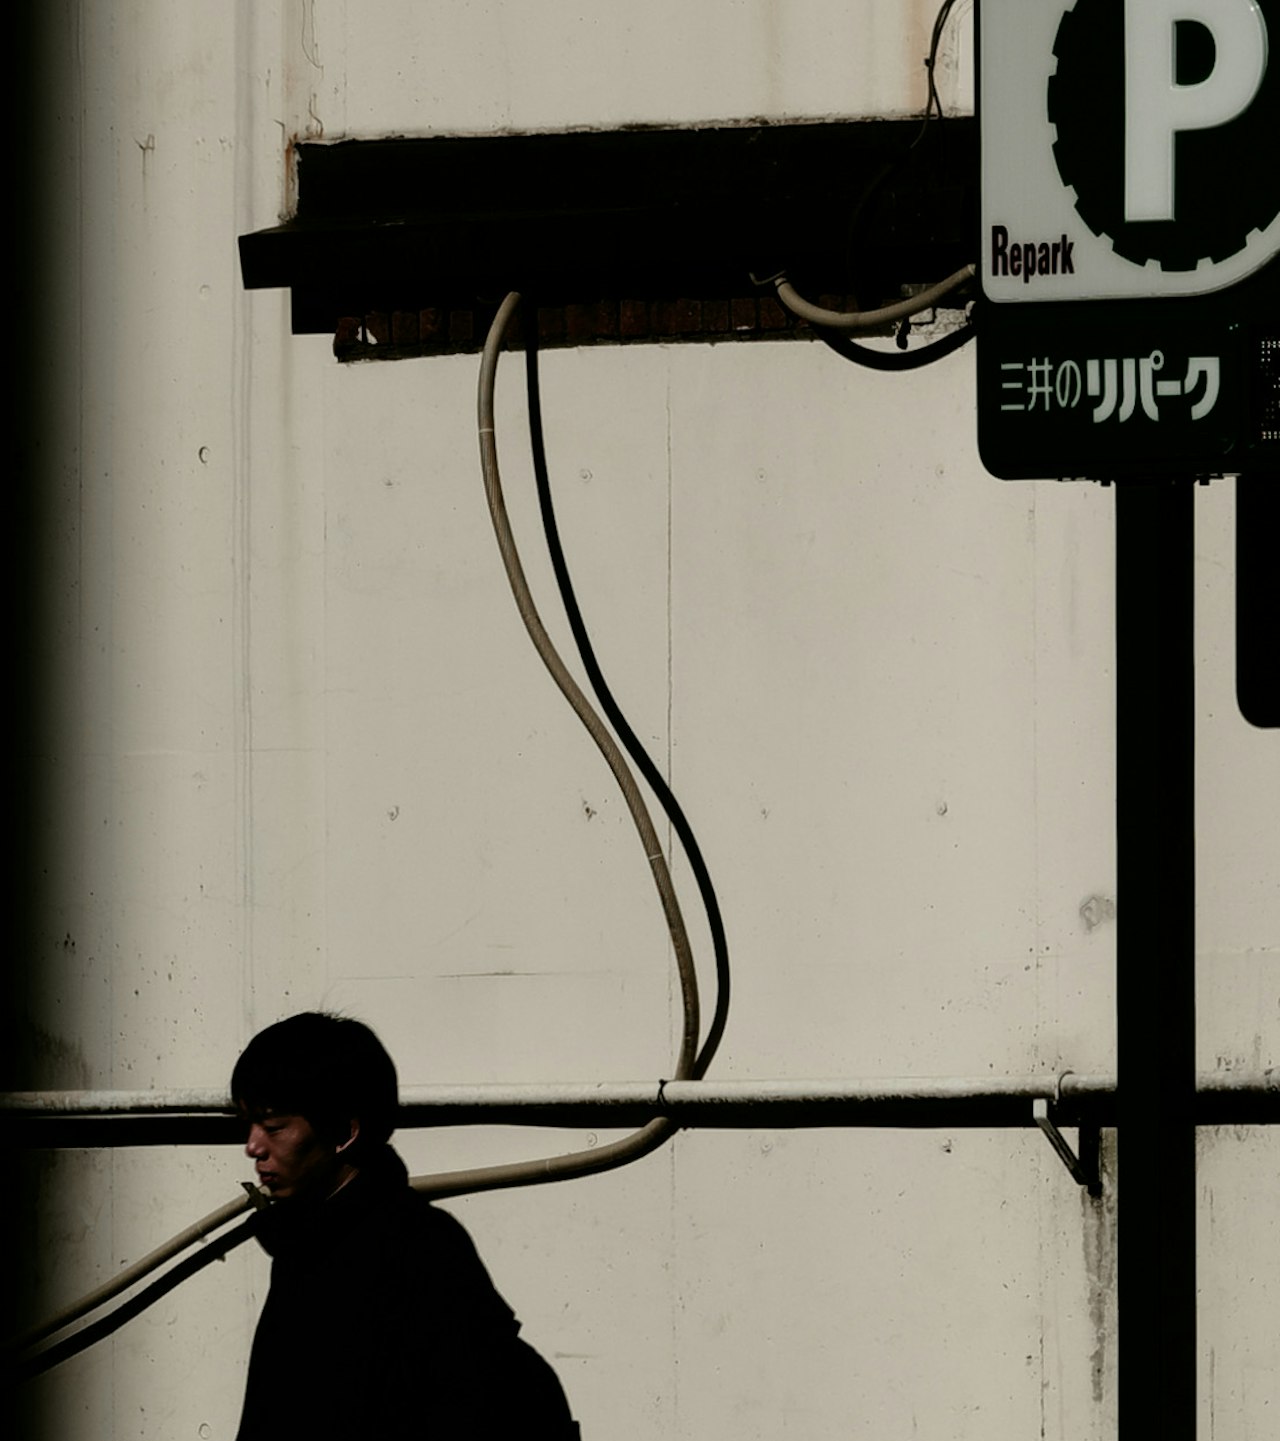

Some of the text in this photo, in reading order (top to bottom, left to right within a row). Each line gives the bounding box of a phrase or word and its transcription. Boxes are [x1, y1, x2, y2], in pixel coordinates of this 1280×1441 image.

[991, 225, 1074, 283] Repark
[1001, 349, 1220, 423] 三井のリパーク
